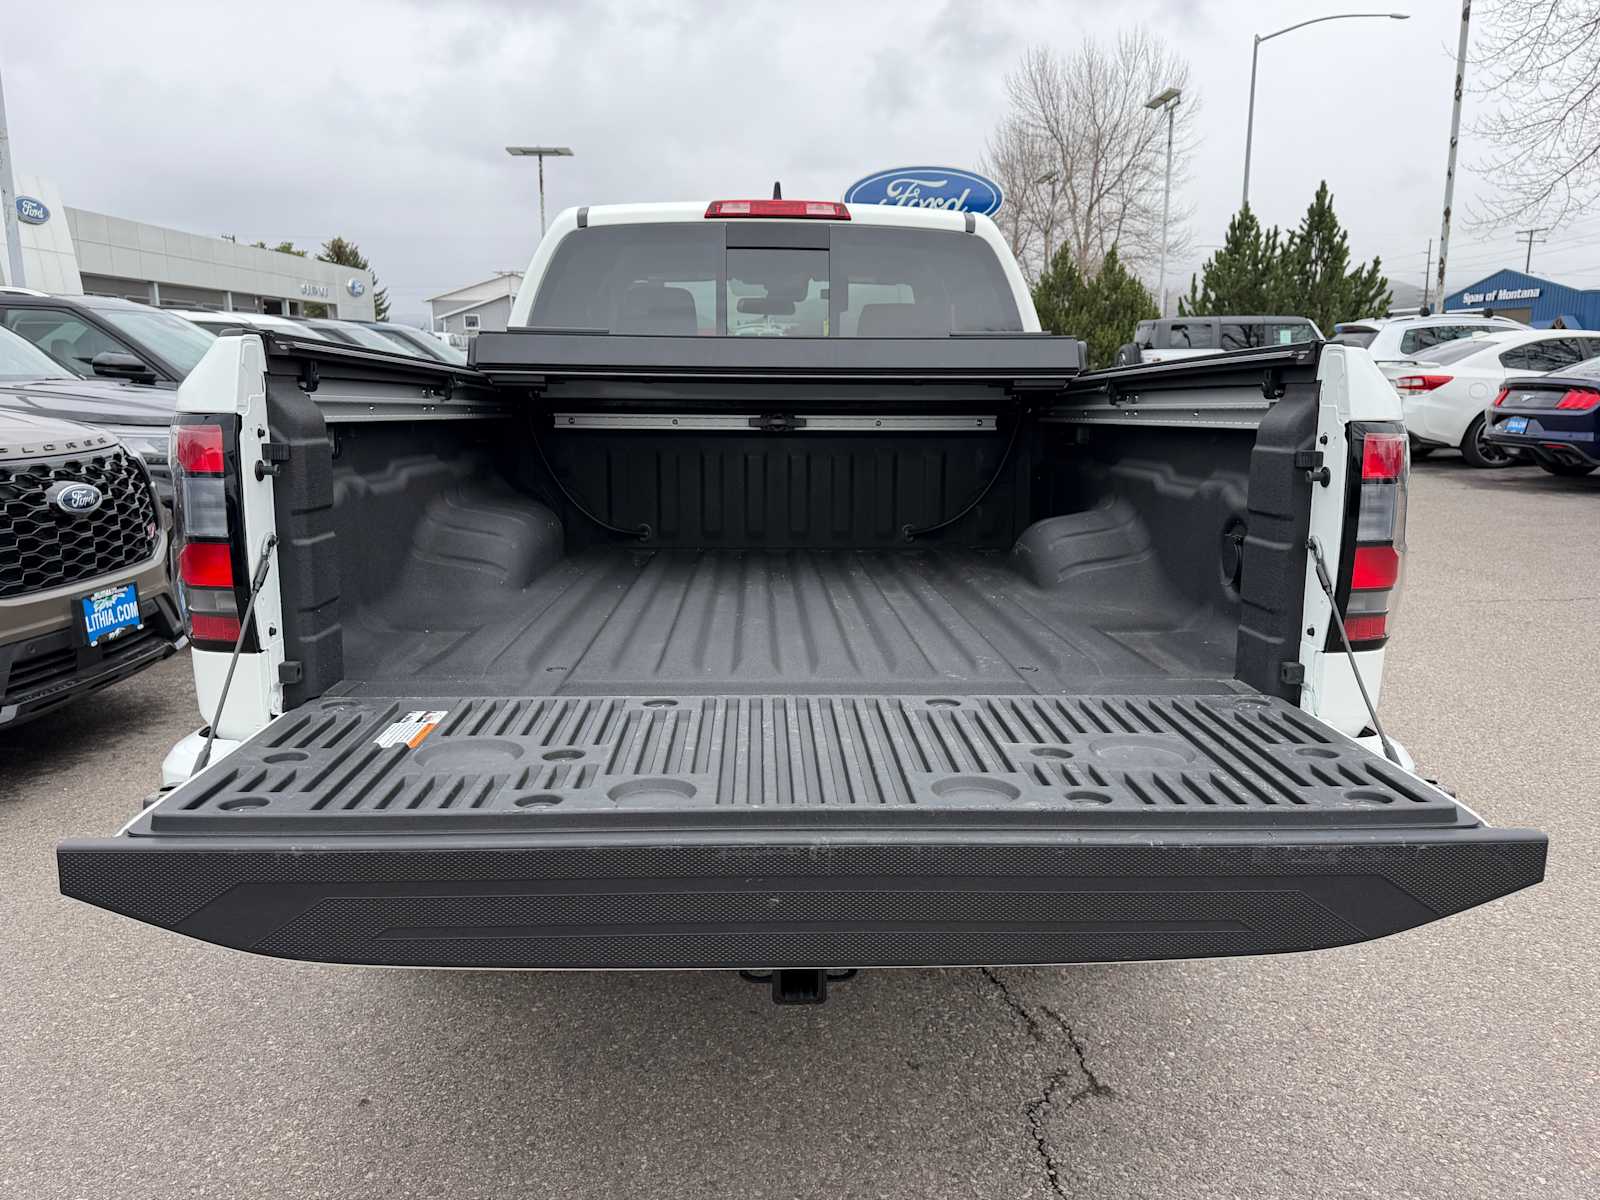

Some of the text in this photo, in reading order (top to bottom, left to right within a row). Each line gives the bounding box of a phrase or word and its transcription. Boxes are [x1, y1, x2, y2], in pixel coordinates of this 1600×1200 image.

[22, 199, 44, 218] Ford
[1462, 287, 1541, 305] Spas of Montana
[71, 490, 96, 508] Ford
[85, 600, 139, 633] LITHIA.COM
